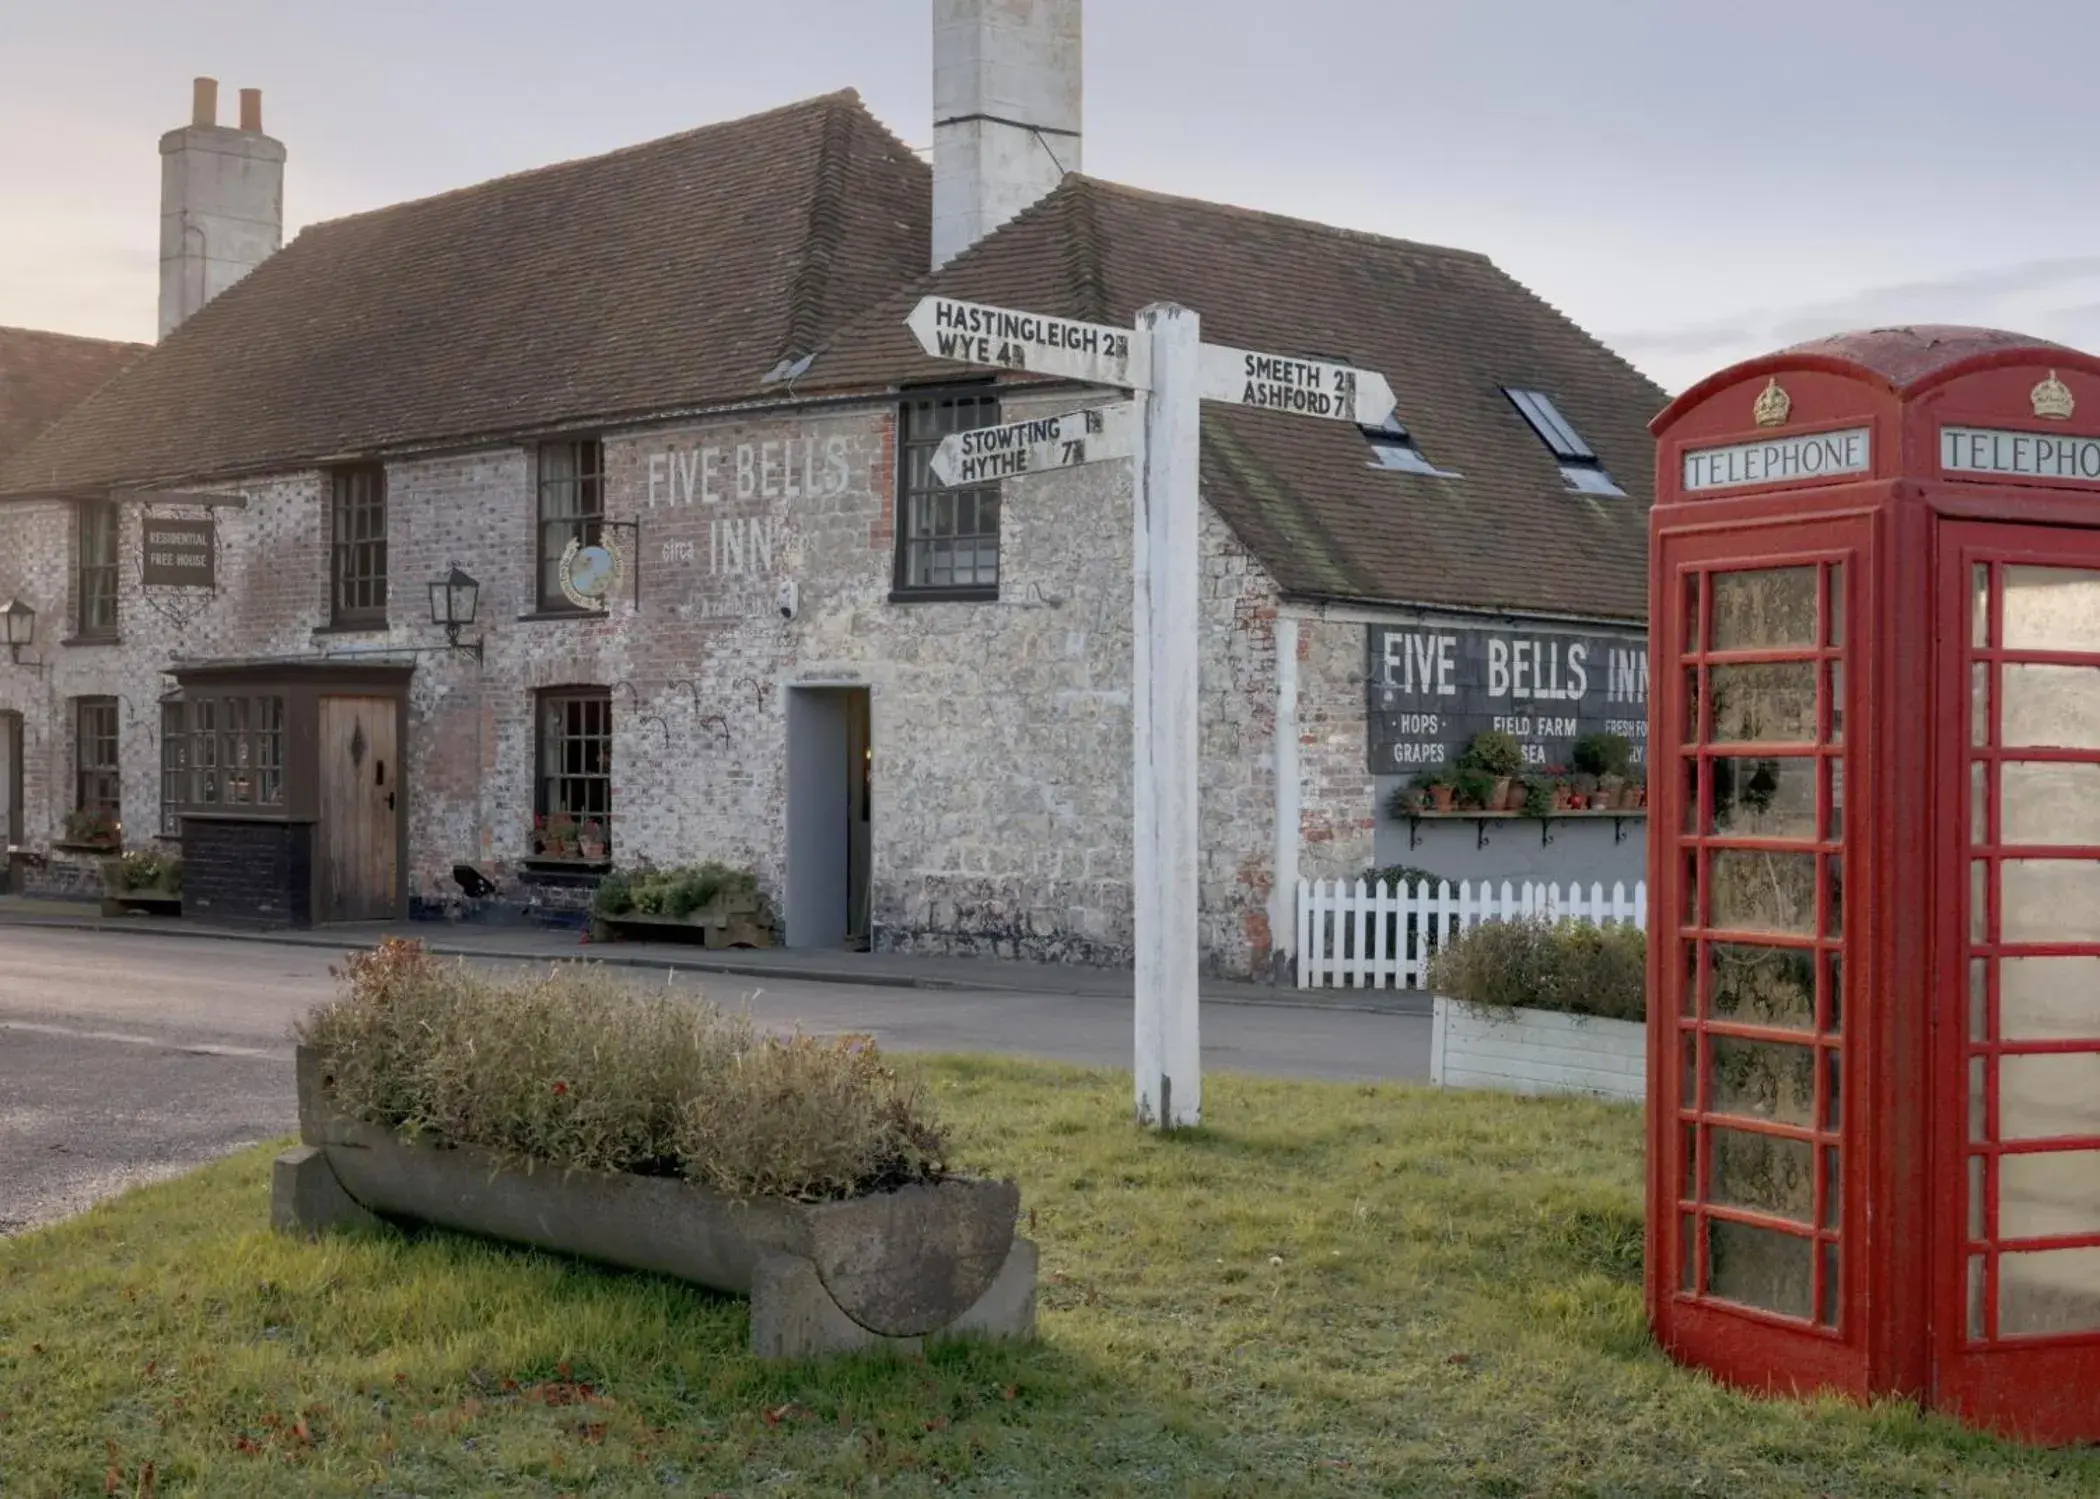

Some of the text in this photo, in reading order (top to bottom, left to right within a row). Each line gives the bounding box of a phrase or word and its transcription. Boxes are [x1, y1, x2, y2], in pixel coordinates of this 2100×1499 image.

[936, 301, 1098, 354] HASTINGLEIGH
[936, 331, 990, 363] WYE
[1245, 354, 1320, 388] SMEETH
[1242, 381, 1331, 414] ASHFORD
[962, 417, 1060, 455] STOWTING
[649, 433, 850, 507] FIVE BELLS
[961, 449, 1028, 481] HYTHE
[1688, 435, 1861, 488] TELEPHONE
[709, 515, 772, 576] INN
[1383, 632, 1457, 696] FIVE
[1488, 638, 1588, 701] BELLS
[1401, 714, 1439, 734] HOPS
[1493, 716, 1577, 737] FIELD FARM
[1605, 719, 1635, 737] FRESH
[1394, 743, 1445, 763] GRAPES
[1520, 744, 1546, 764] SEA
